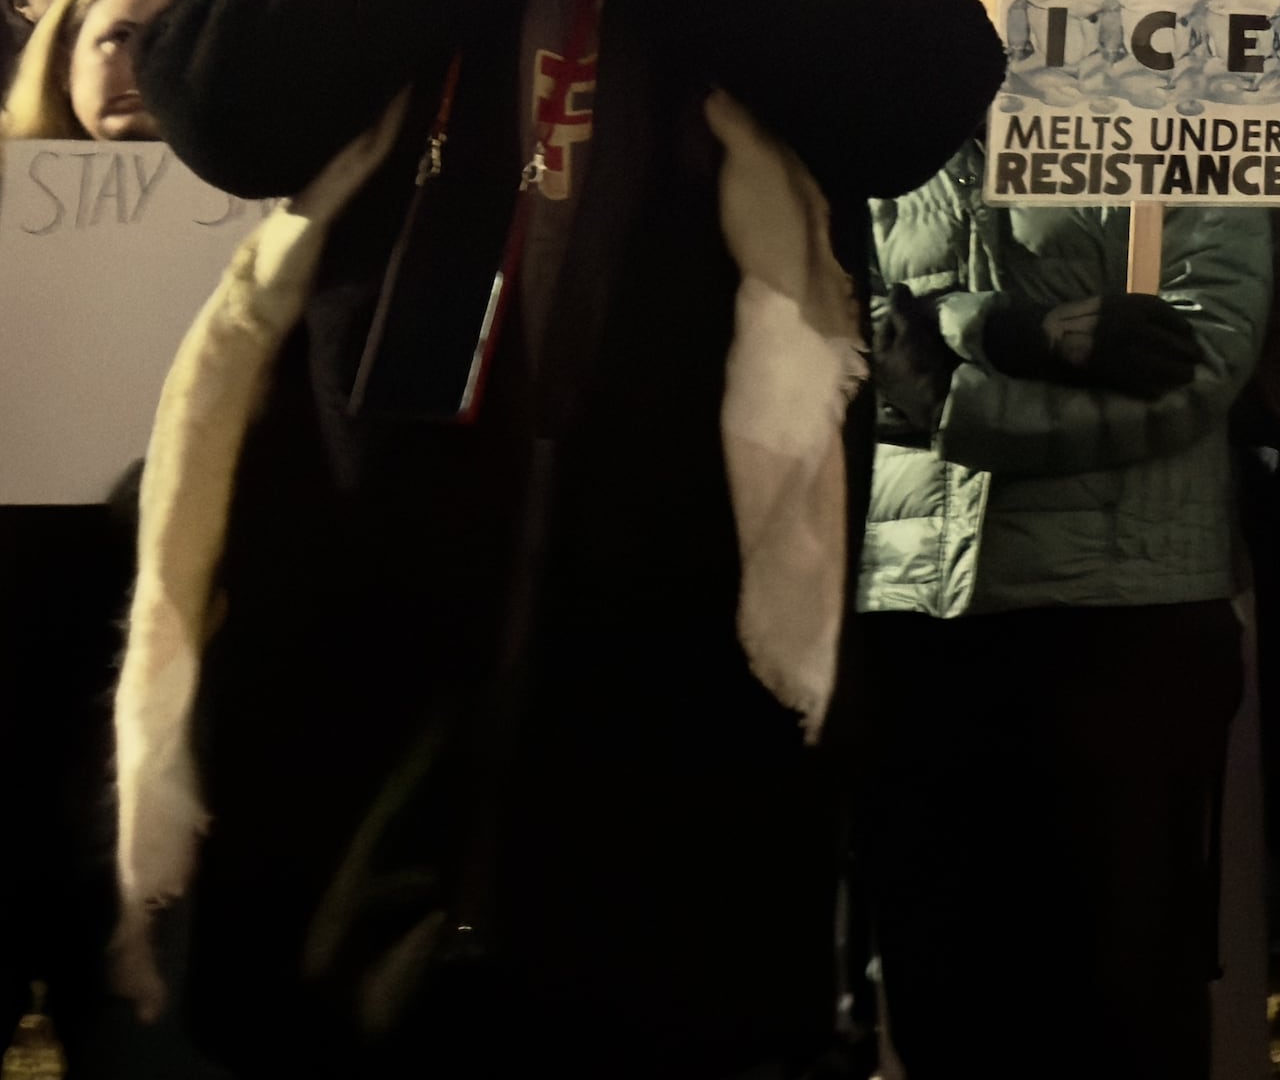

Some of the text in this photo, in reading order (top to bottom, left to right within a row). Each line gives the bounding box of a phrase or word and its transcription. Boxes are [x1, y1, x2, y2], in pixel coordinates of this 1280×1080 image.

[1046, 6, 1273, 73] ICE
[1003, 115, 1133, 151] MELTS
[20, 150, 173, 236] STAY
